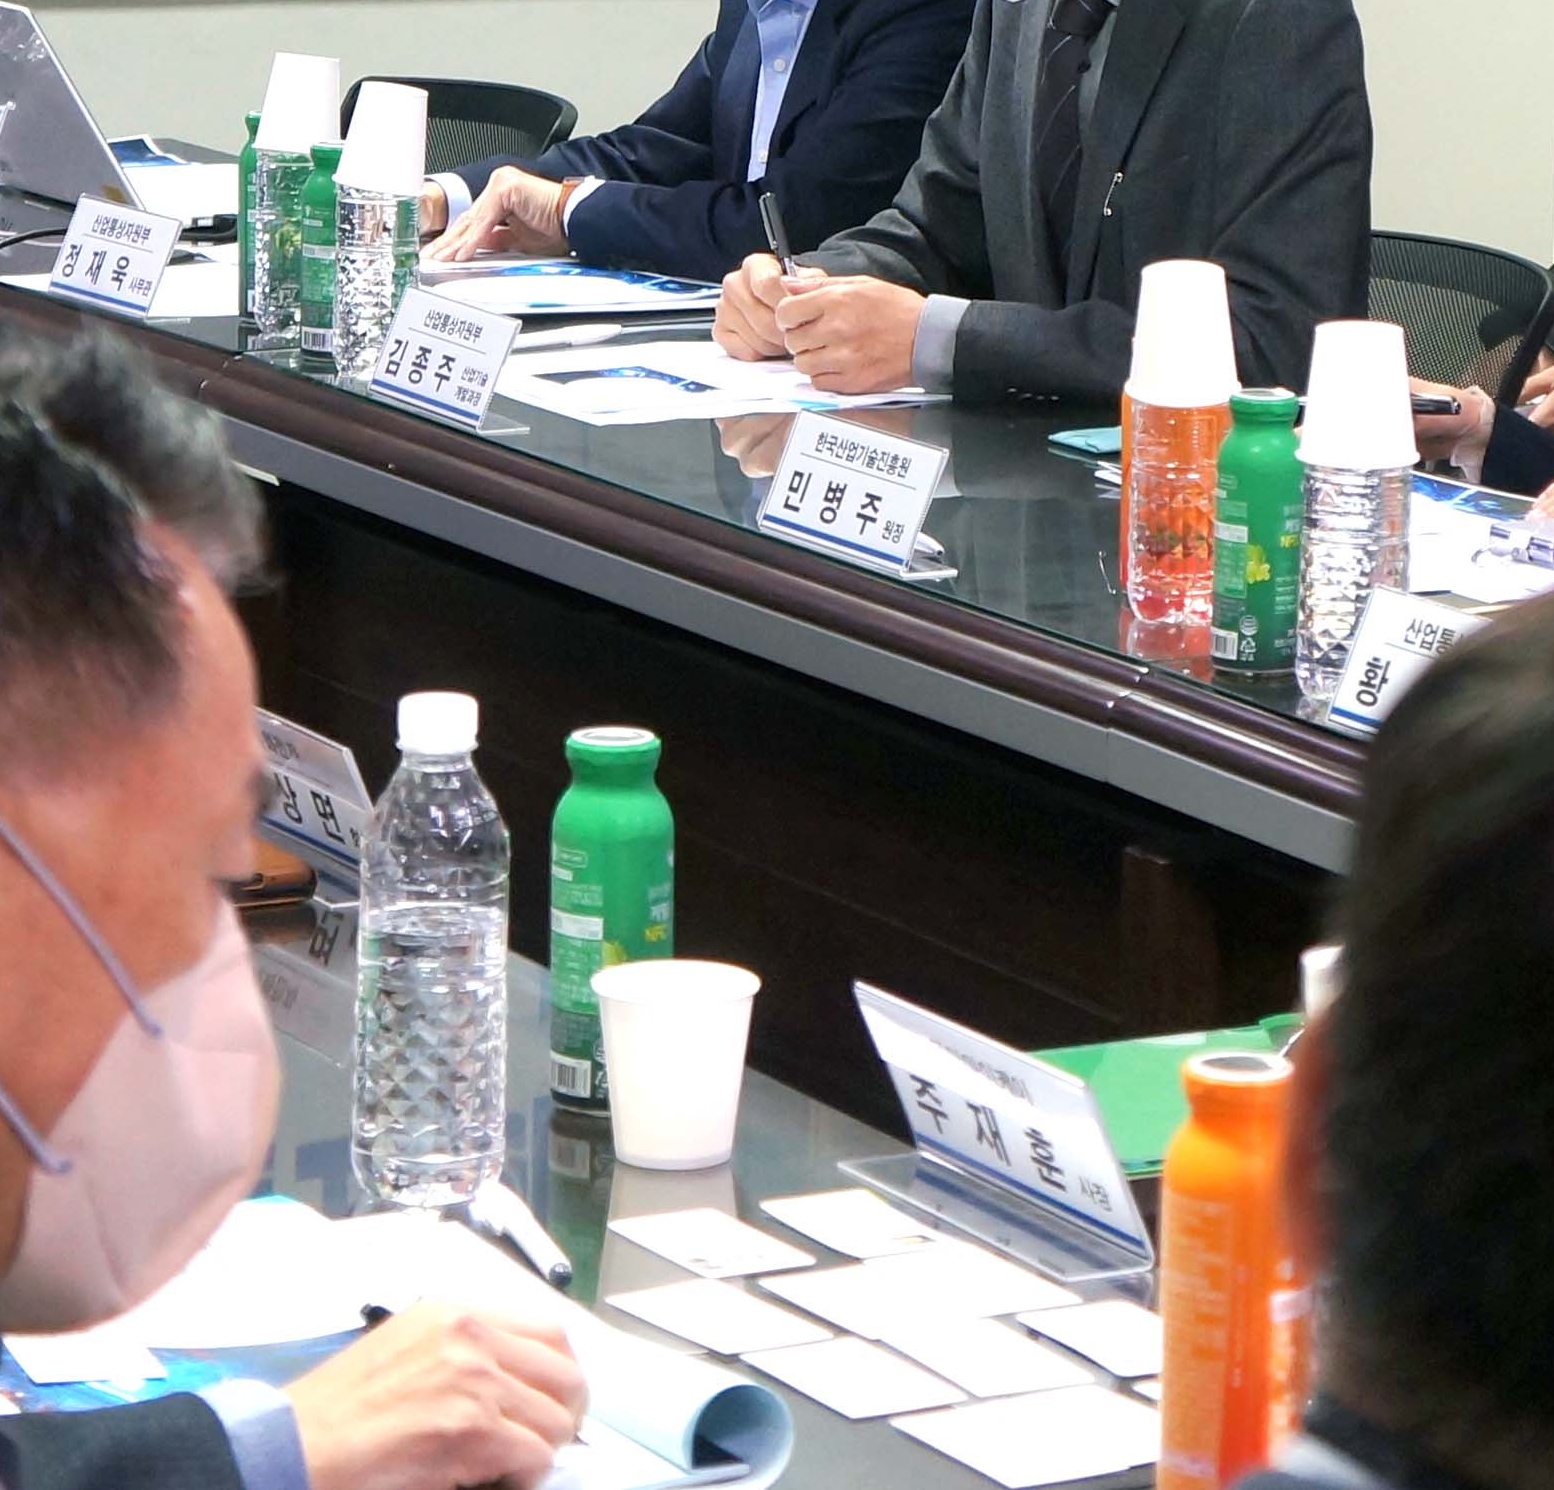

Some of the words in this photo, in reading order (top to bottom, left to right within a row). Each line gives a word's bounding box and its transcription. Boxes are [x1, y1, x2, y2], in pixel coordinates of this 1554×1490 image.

[91, 214, 153, 246] 산업통상자원부
[423, 309, 485, 344] 산업통상자원부
[814, 431, 913, 480] 한국산업기술진흥원
[881, 519, 905, 544] 원장
